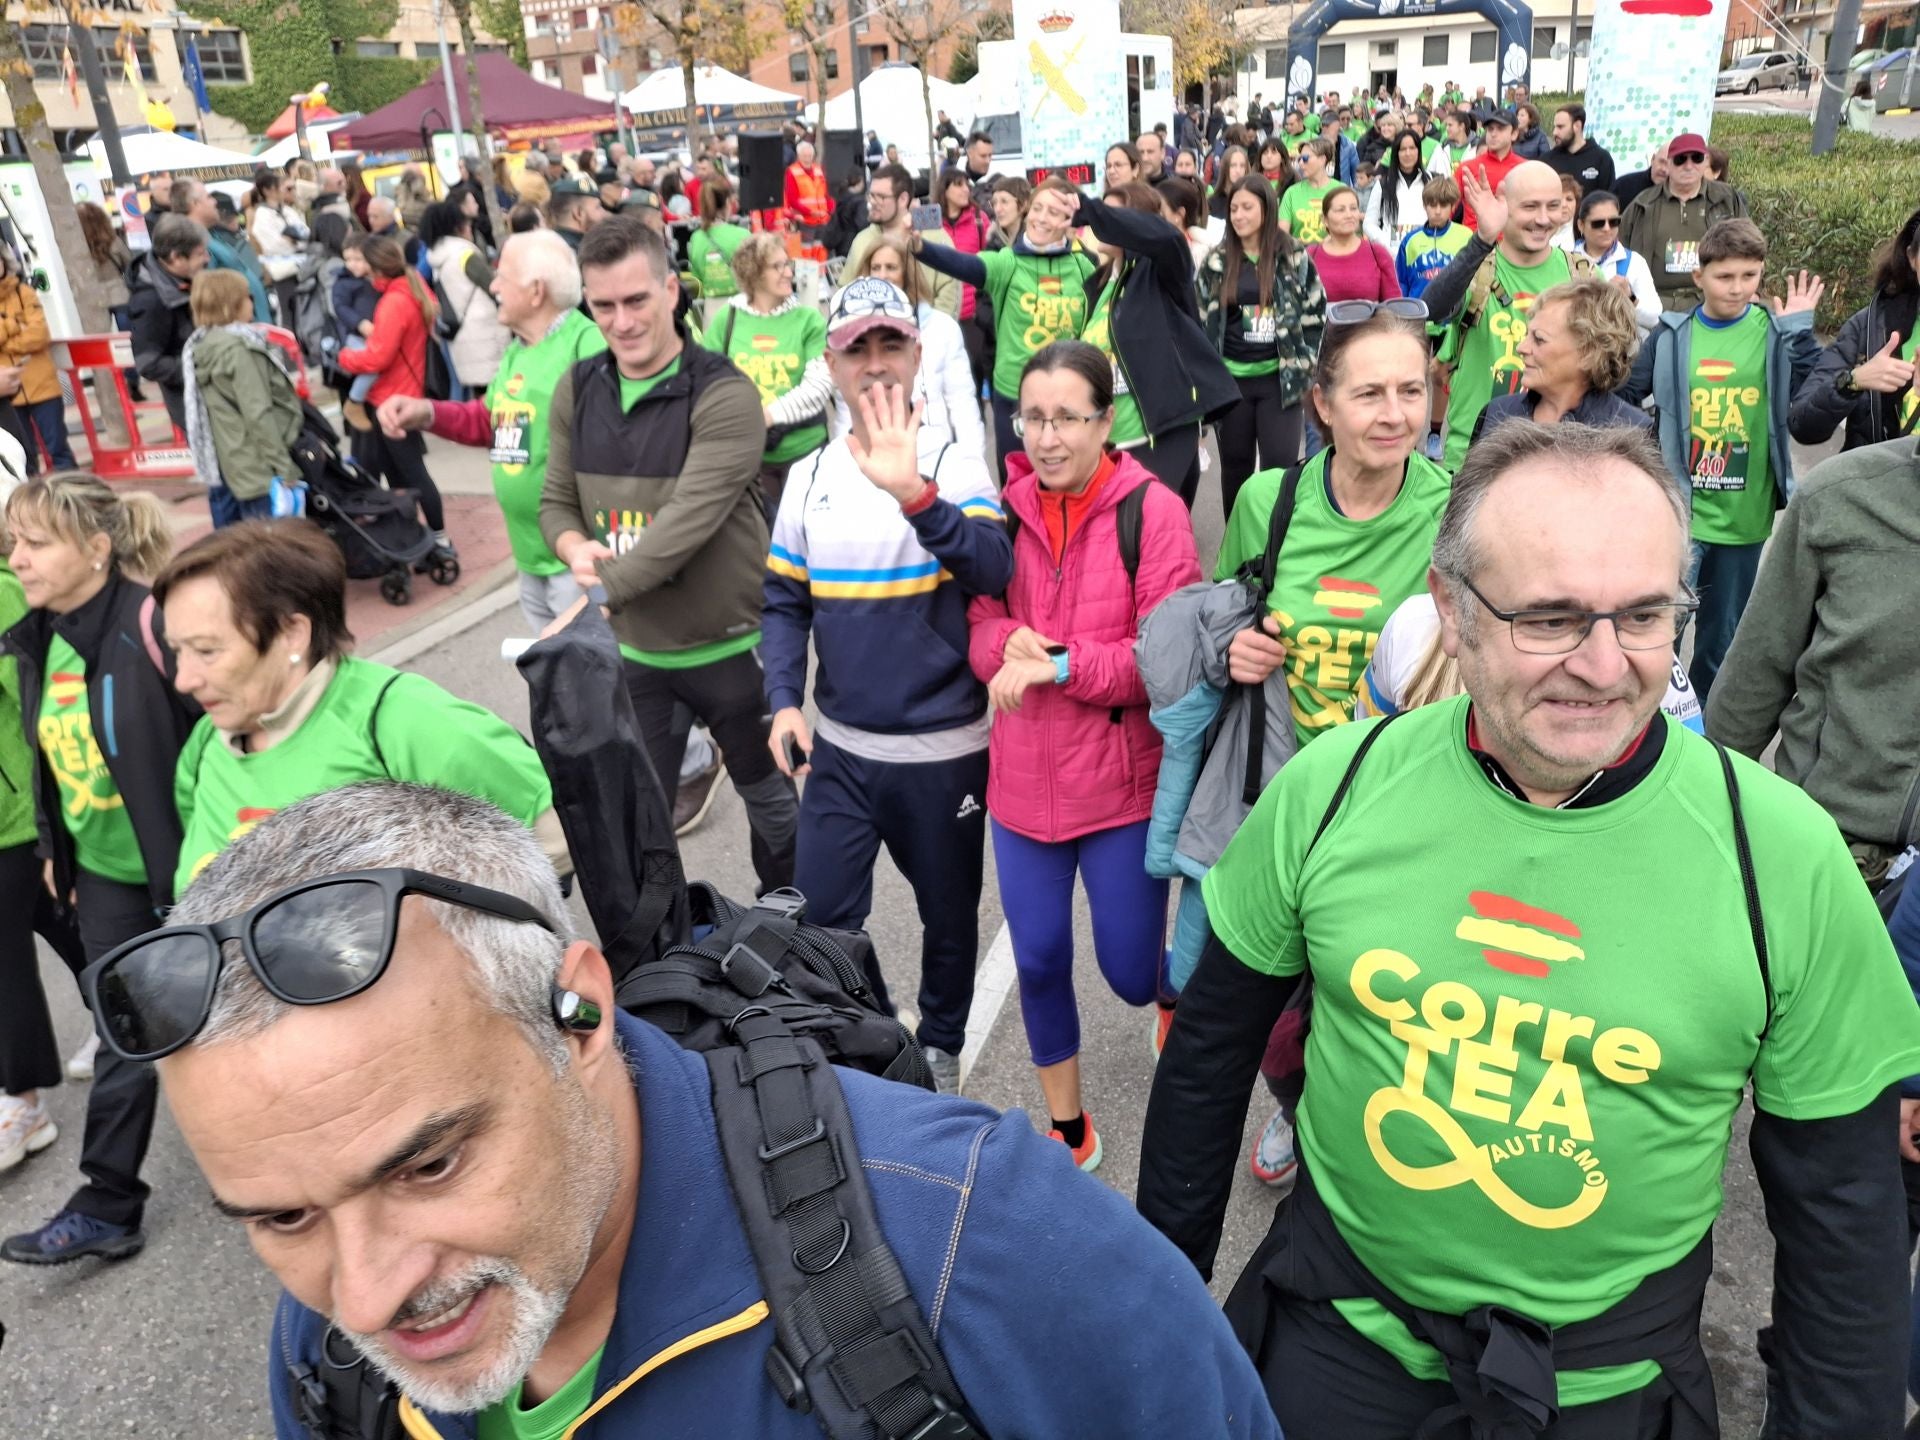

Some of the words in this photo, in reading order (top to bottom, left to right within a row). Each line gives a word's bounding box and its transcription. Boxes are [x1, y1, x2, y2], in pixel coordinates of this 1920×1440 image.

[1690, 386, 1761, 406] orre
[1696, 456, 1725, 477] 40
[1270, 610, 1378, 659] Corr
[1350, 948, 1662, 1085] Corre
[1390, 1018, 1595, 1142] TEA
[1491, 1134, 1606, 1187] AUTISMO
